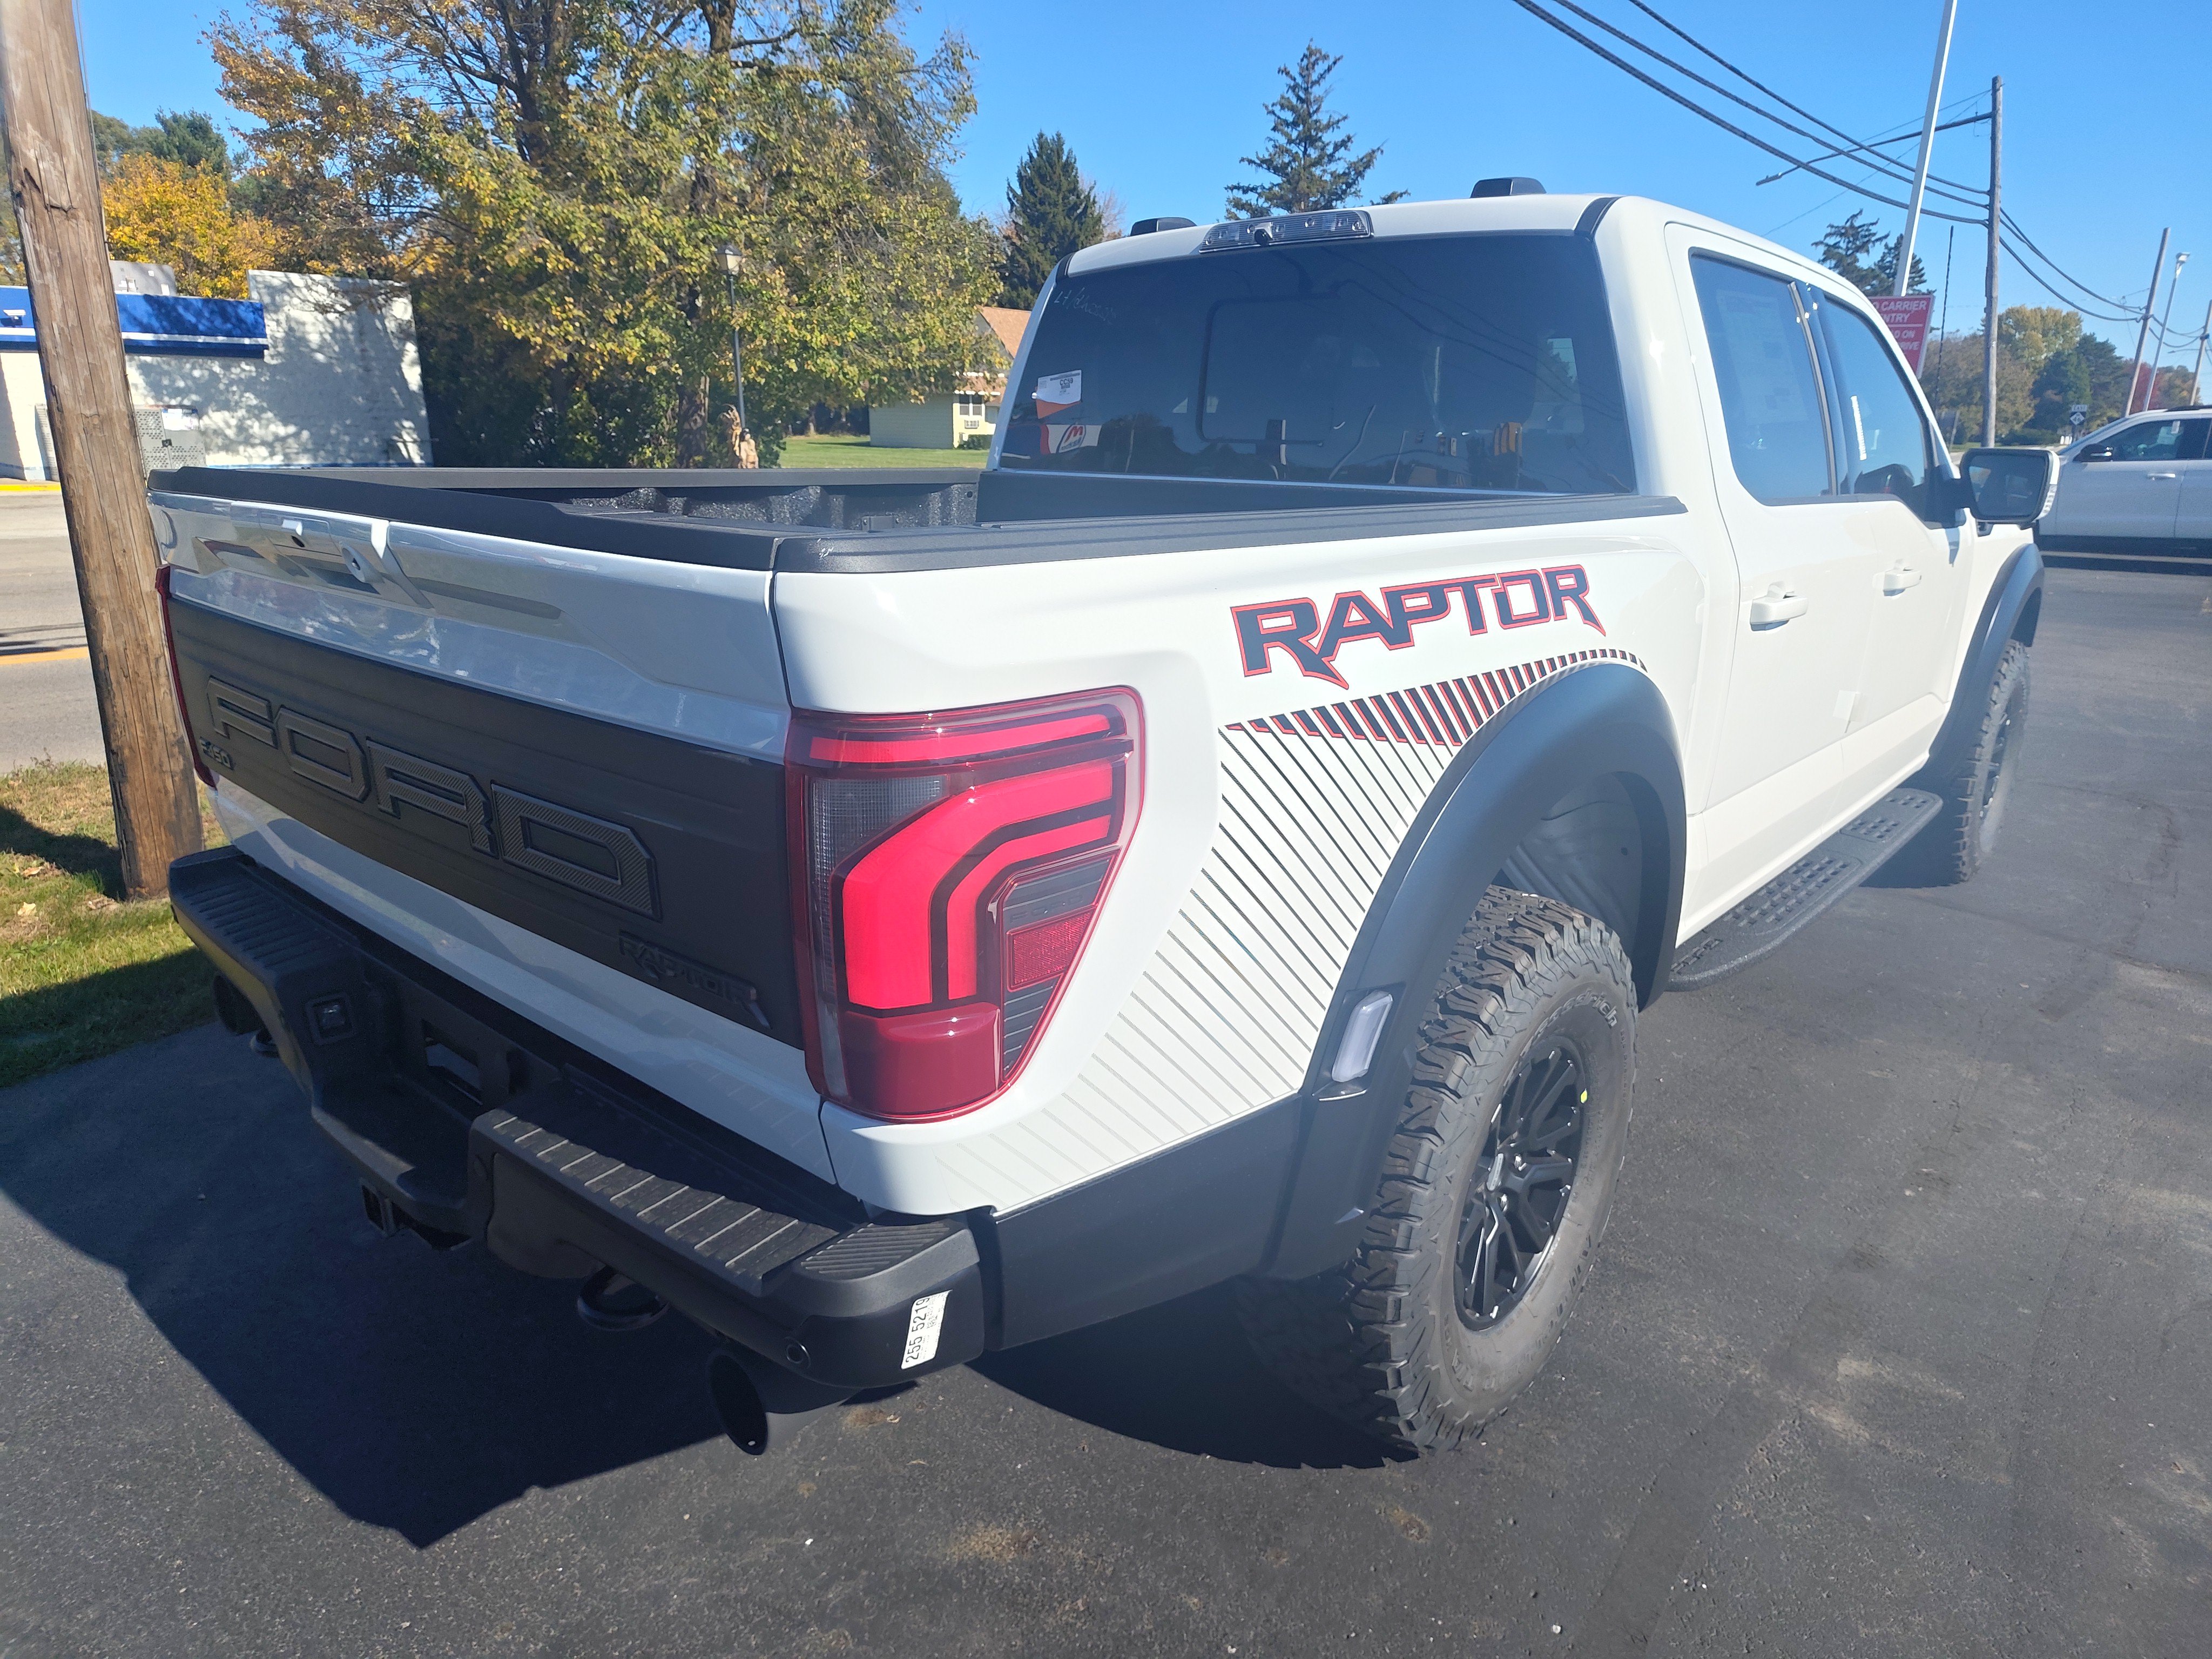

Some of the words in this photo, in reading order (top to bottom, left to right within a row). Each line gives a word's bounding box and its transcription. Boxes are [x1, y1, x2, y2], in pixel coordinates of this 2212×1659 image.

[1880, 313, 1910, 323] NTRY
[1881, 300, 1927, 311] CARRIER
[1230, 564, 1606, 690] RAPTOR
[206, 675, 663, 922] FORD
[912, 1298, 930, 1332] 5219
[906, 1336, 922, 1363] 255
